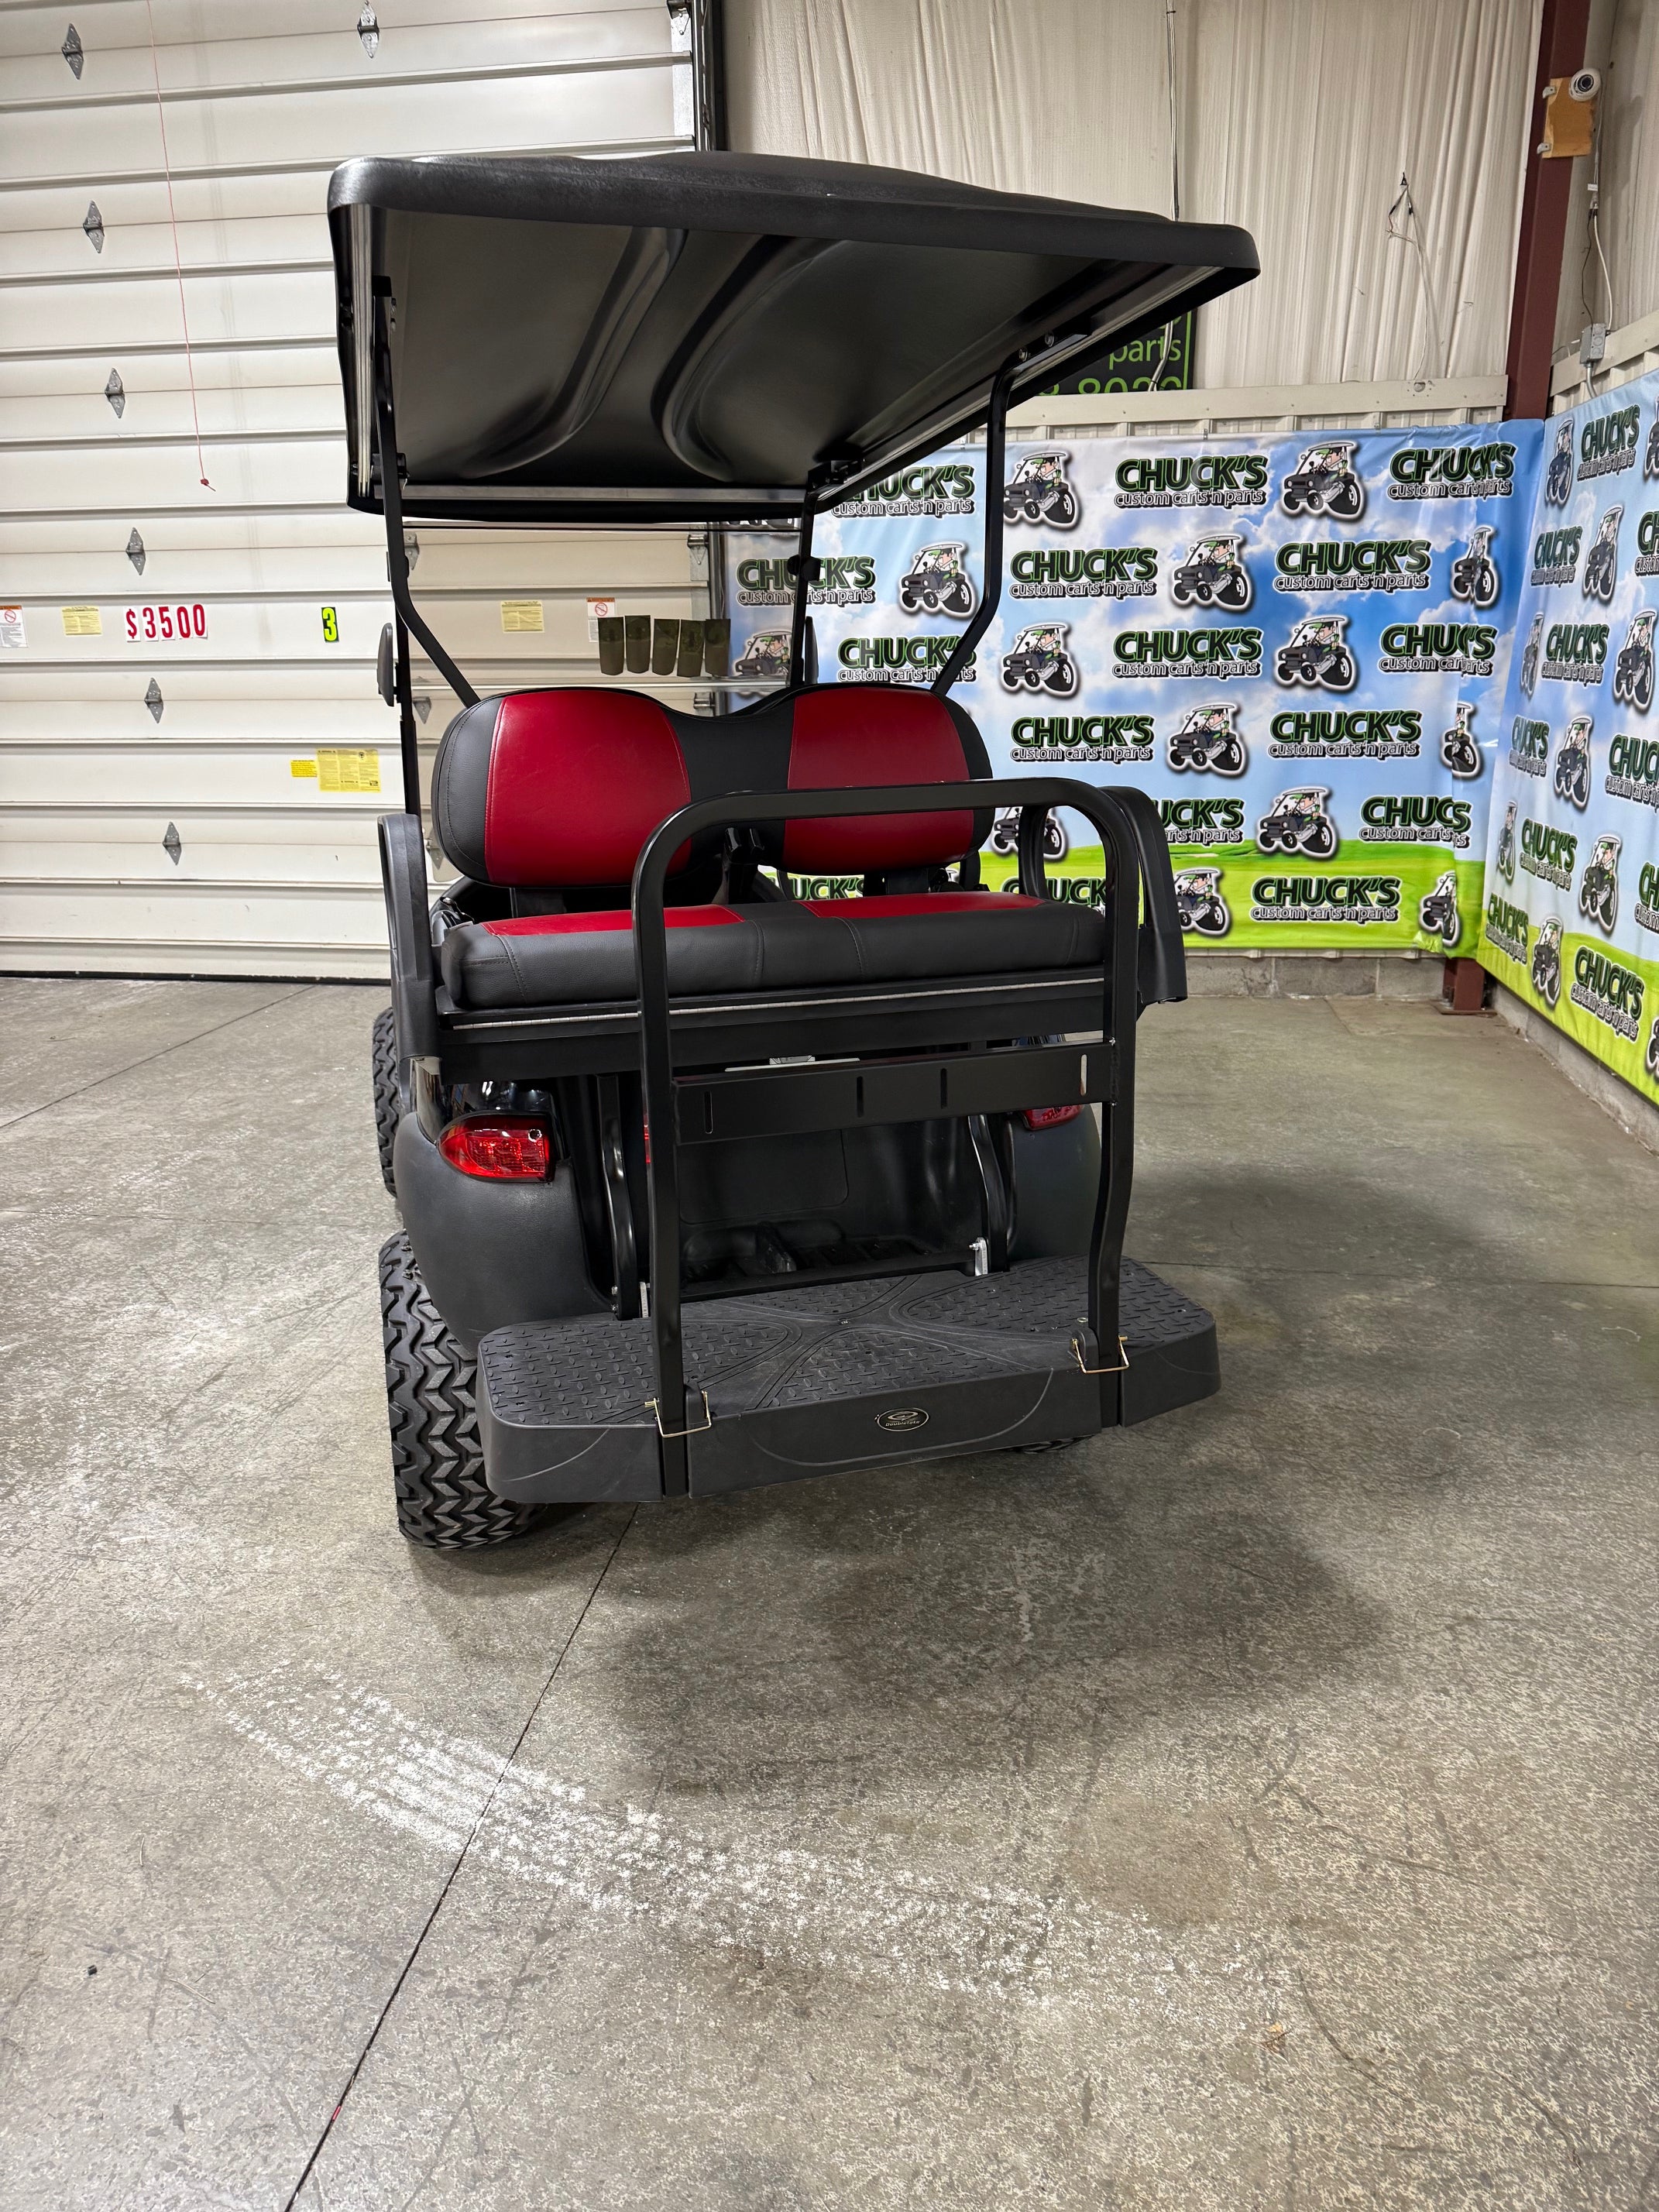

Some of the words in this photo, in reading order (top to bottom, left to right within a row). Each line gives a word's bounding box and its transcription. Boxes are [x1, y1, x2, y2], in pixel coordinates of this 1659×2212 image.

[1109, 336, 1181, 370] parts
[1581, 404, 1640, 462] CHUCK'S
[1115, 455, 1268, 493] CHUCK'S
[1390, 443, 1516, 483] CHUCK'S
[847, 465, 975, 501] UCK'S
[1387, 483, 1448, 500] custom
[831, 500, 886, 517] custom
[934, 498, 974, 518] parts
[1115, 491, 1172, 508] custom
[1223, 489, 1266, 510] parts
[1276, 540, 1431, 576] CHUCK'S
[1534, 526, 1583, 568] CHUCK'S
[1010, 547, 1158, 584] CHUCK'S
[737, 590, 792, 606] custom
[836, 589, 876, 607] parts
[1009, 583, 1066, 599] custom
[1115, 581, 1157, 600] parts
[1274, 575, 1334, 591] custom
[1385, 573, 1430, 592] parts
[125, 604, 206, 639] $3500
[322, 606, 338, 642] 3
[1114, 628, 1262, 663] CHUCK'S
[1381, 623, 1498, 659] CHUC'S
[1547, 623, 1609, 665] CHUCK'S
[838, 668, 891, 682] custom
[1112, 662, 1169, 678] custom
[1219, 660, 1262, 680] parts
[1379, 658, 1439, 672] custom
[1012, 715, 1154, 747] CHUCK'S
[1270, 709, 1422, 744] CHUCK'S
[1011, 747, 1065, 762] custom
[1112, 746, 1153, 765] parts
[1269, 742, 1327, 758] custom
[1378, 741, 1421, 761] parts
[1152, 799, 1245, 830] UCK'S
[1201, 827, 1243, 847] parts
[1360, 826, 1417, 842] custom
[1522, 819, 1577, 872] CHUCK'S
[1252, 877, 1401, 906] CHUCK'S
[1251, 905, 1307, 921] custom
[1357, 905, 1400, 924] parts
[1575, 946, 1644, 1022] CHUCK'S
